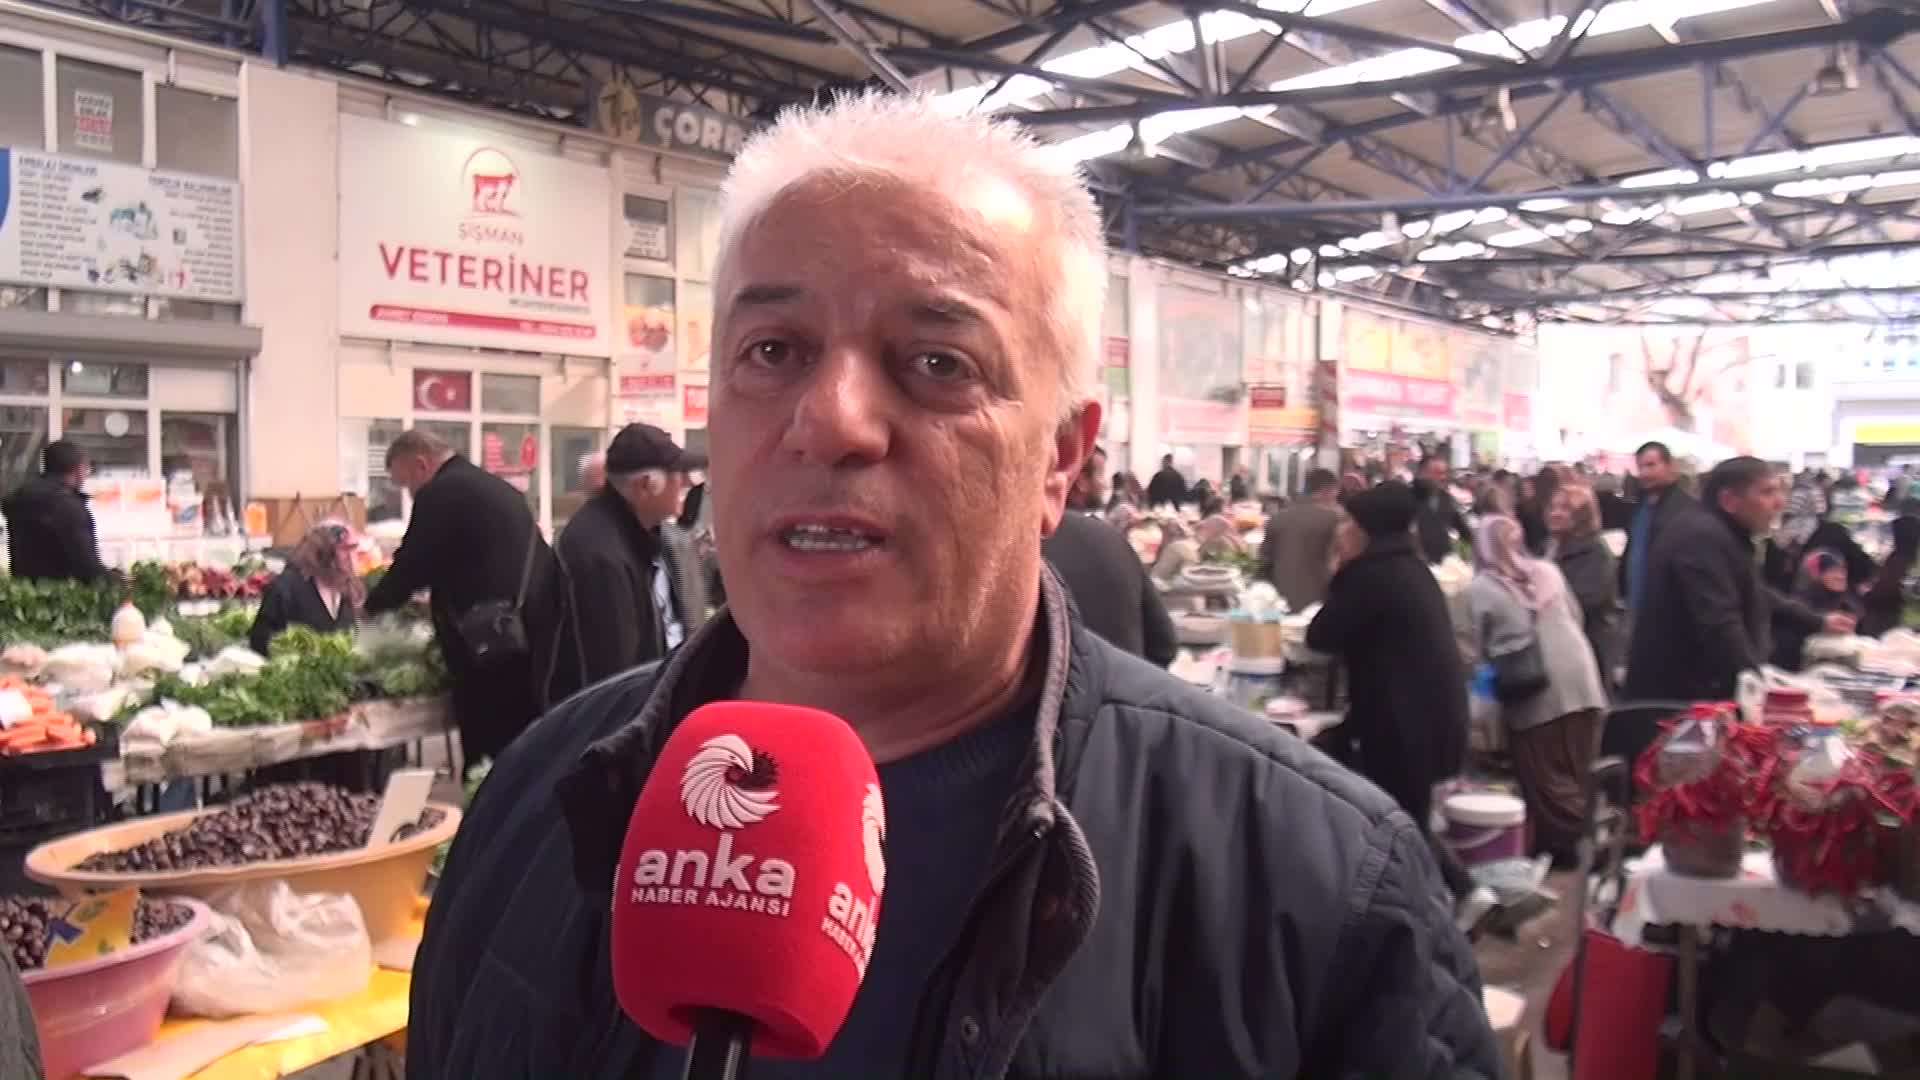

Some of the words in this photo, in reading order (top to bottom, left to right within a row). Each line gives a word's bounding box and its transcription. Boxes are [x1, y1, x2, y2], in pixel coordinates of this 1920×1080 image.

[378, 242, 589, 301] VETERİNER
[633, 832, 797, 897] anka
[631, 887, 698, 905] HABER
[704, 891, 790, 917] AJANSI
